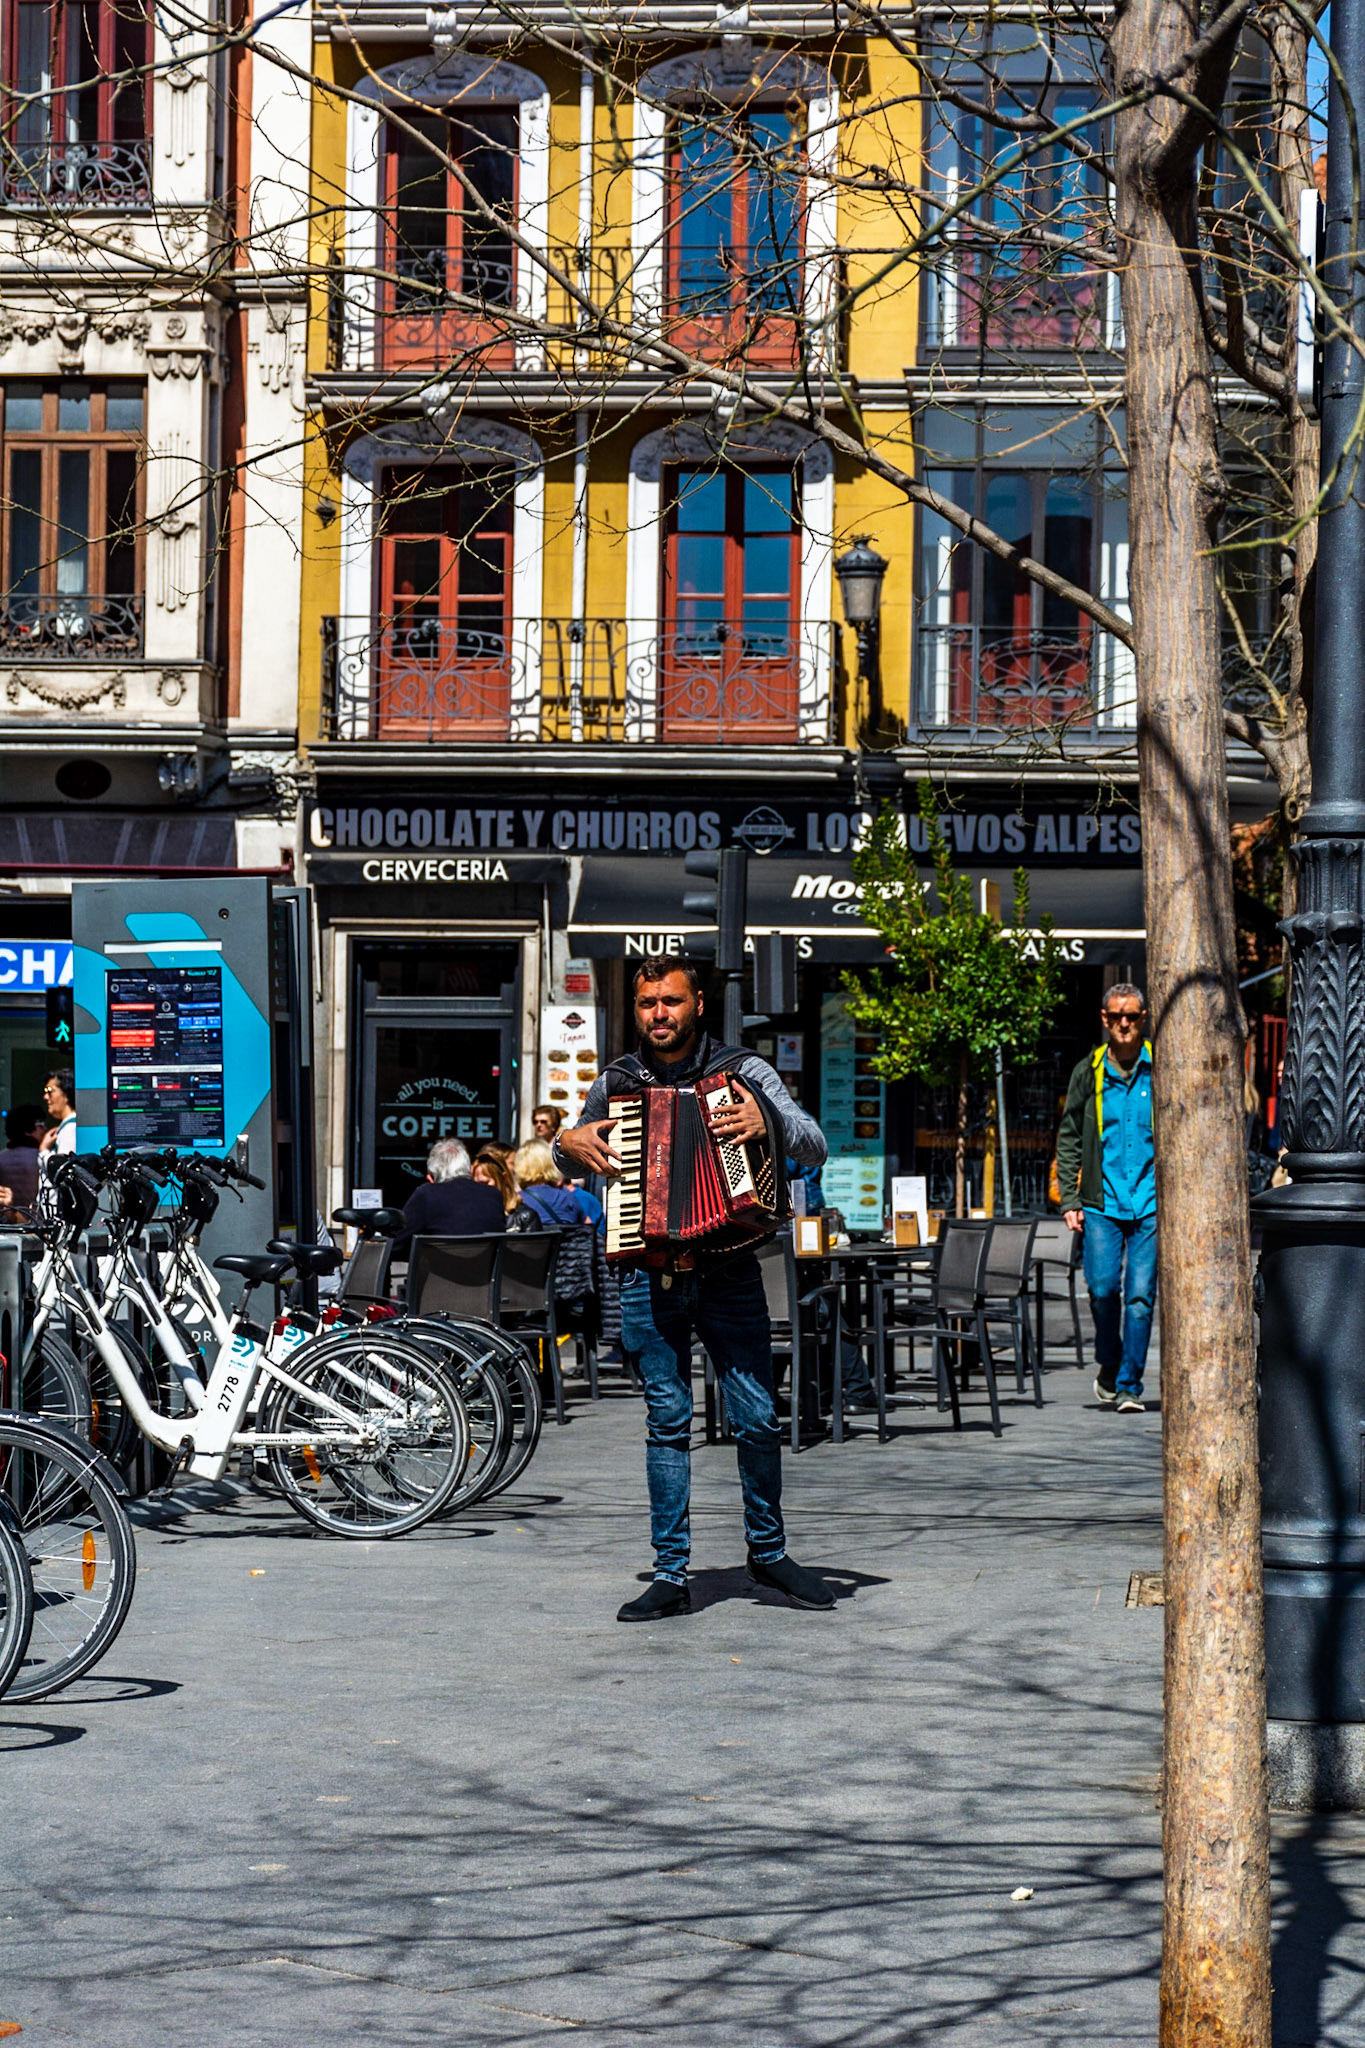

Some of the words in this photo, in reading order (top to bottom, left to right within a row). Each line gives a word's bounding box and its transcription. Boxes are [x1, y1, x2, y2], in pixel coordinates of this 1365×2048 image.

[311, 807, 515, 848] CHOCOLATE
[522, 809, 545, 848] Y
[552, 809, 722, 851] CHURROS
[807, 811, 875, 853] LOS
[1033, 813, 1141, 853] ALPES
[398, 1083, 415, 1101] all
[414, 1077, 441, 1095] you
[442, 1077, 479, 1103] need
[432, 1097, 444, 1111] is
[382, 1115, 494, 1139] COFFEE
[217, 1376, 239, 1412] 2778
